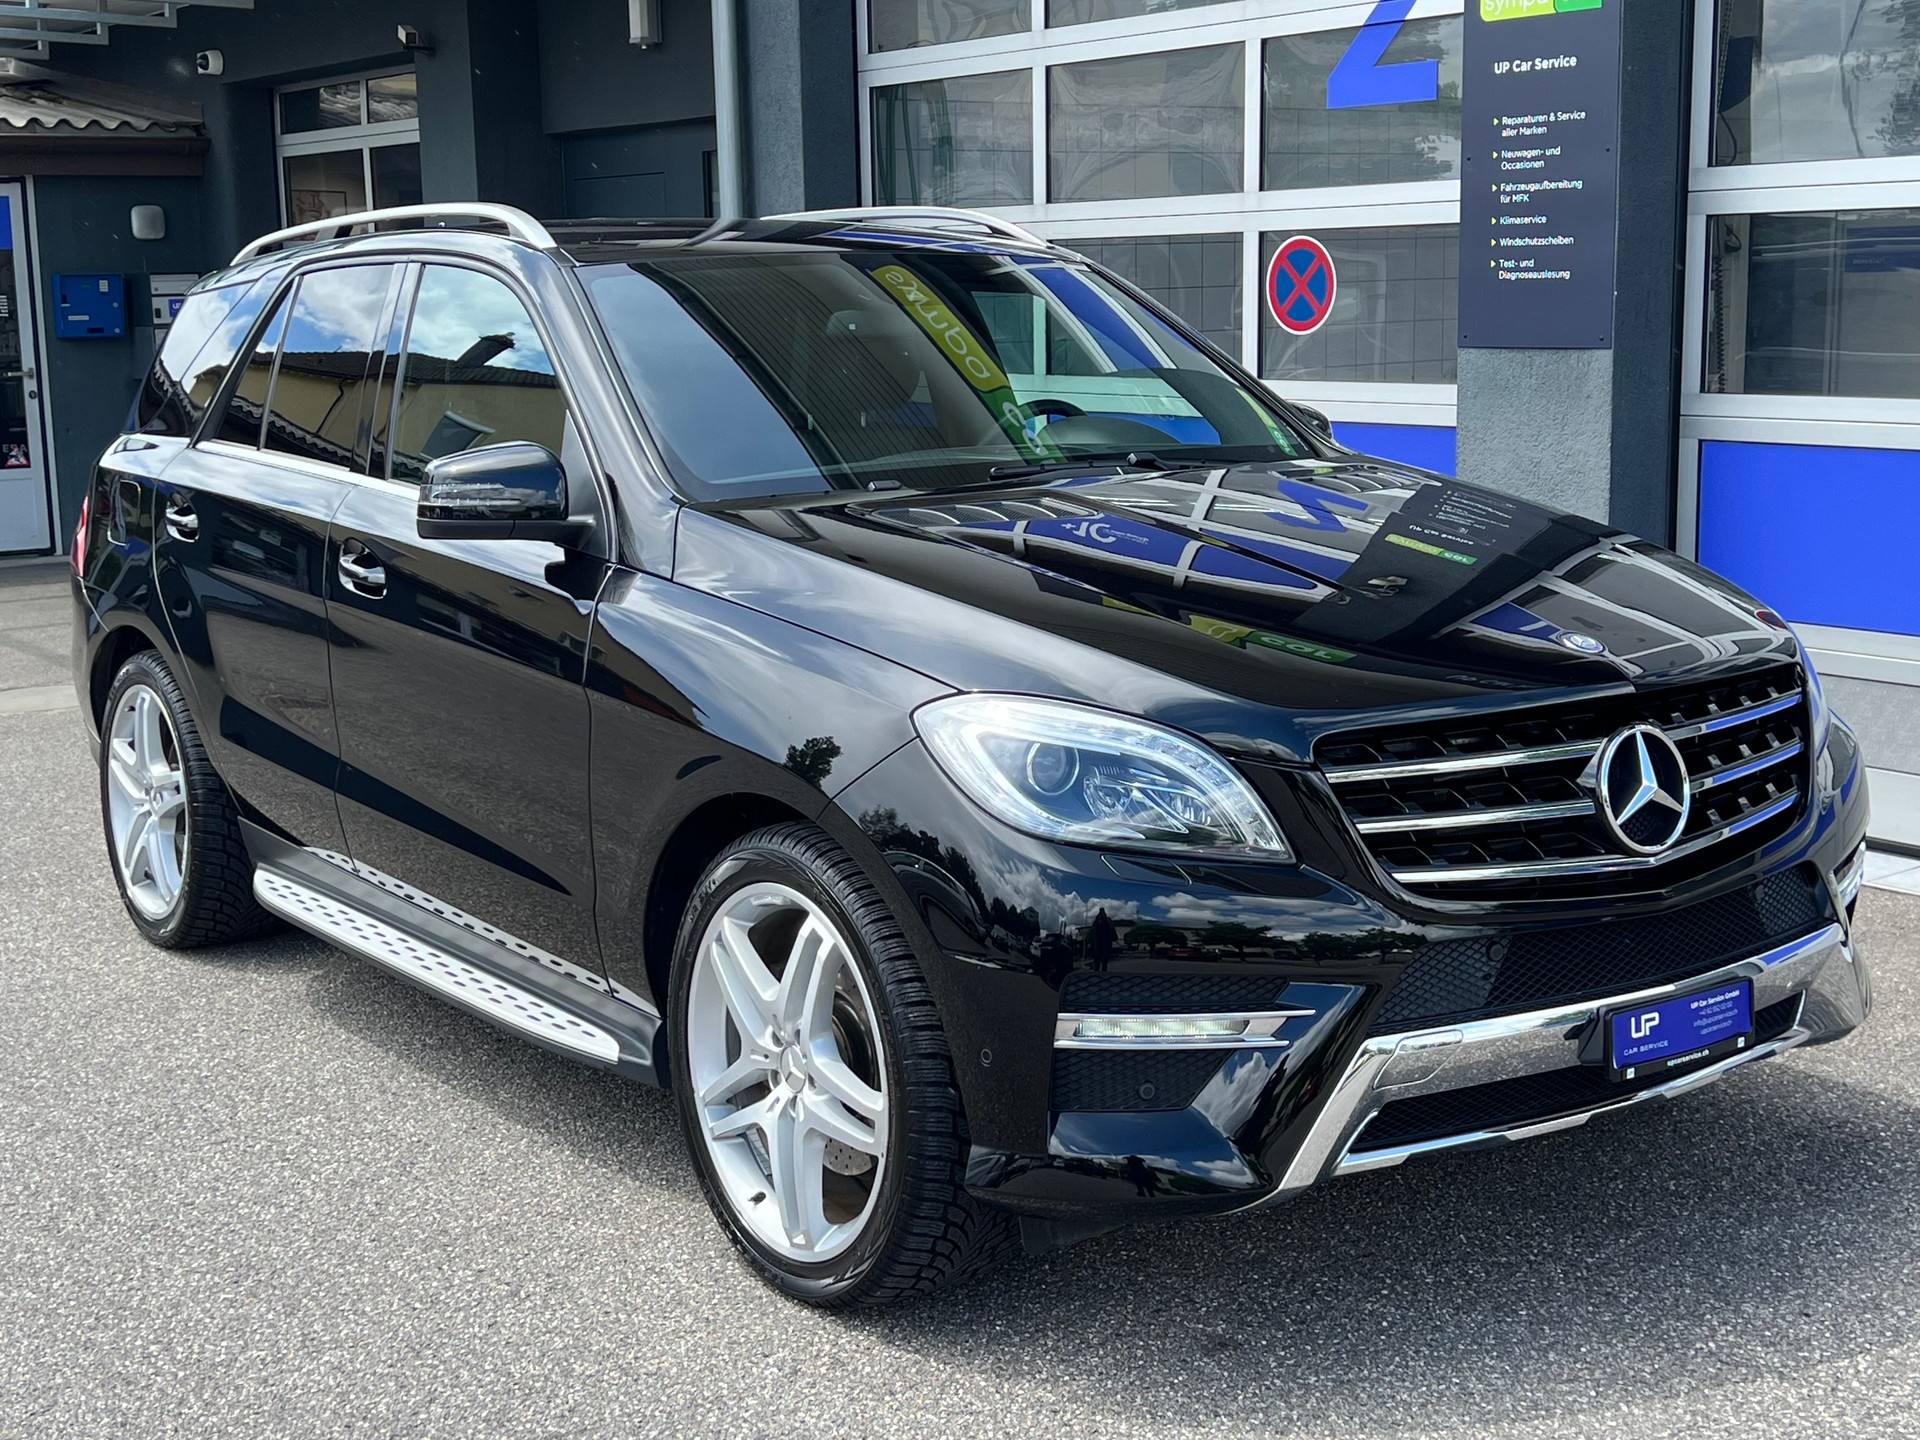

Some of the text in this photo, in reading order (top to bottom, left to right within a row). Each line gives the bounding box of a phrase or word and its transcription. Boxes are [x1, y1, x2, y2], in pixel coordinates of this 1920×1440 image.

[1485, 0, 1549, 15] symp
[1494, 55, 1577, 74] UP Car Service
[1502, 110, 1586, 126] Reparaturen & Service
[1502, 126, 1547, 137] aller Marken
[1501, 146, 1561, 159] Neuwagen- und
[1501, 160, 1545, 170] Occasionen
[1500, 180, 1583, 192] Fahrzeugaufbereitung
[1500, 193, 1530, 203] für MFK
[1500, 215, 1547, 225] Klimaservice
[1499, 236, 1574, 247] Windschutzscheiben
[1499, 258, 1535, 268] Test- und
[1498, 270, 1571, 281] Diagnoseauslesung
[1630, 1011, 1660, 1039] UP
[1623, 1040, 1669, 1056] CAR SERVICE
